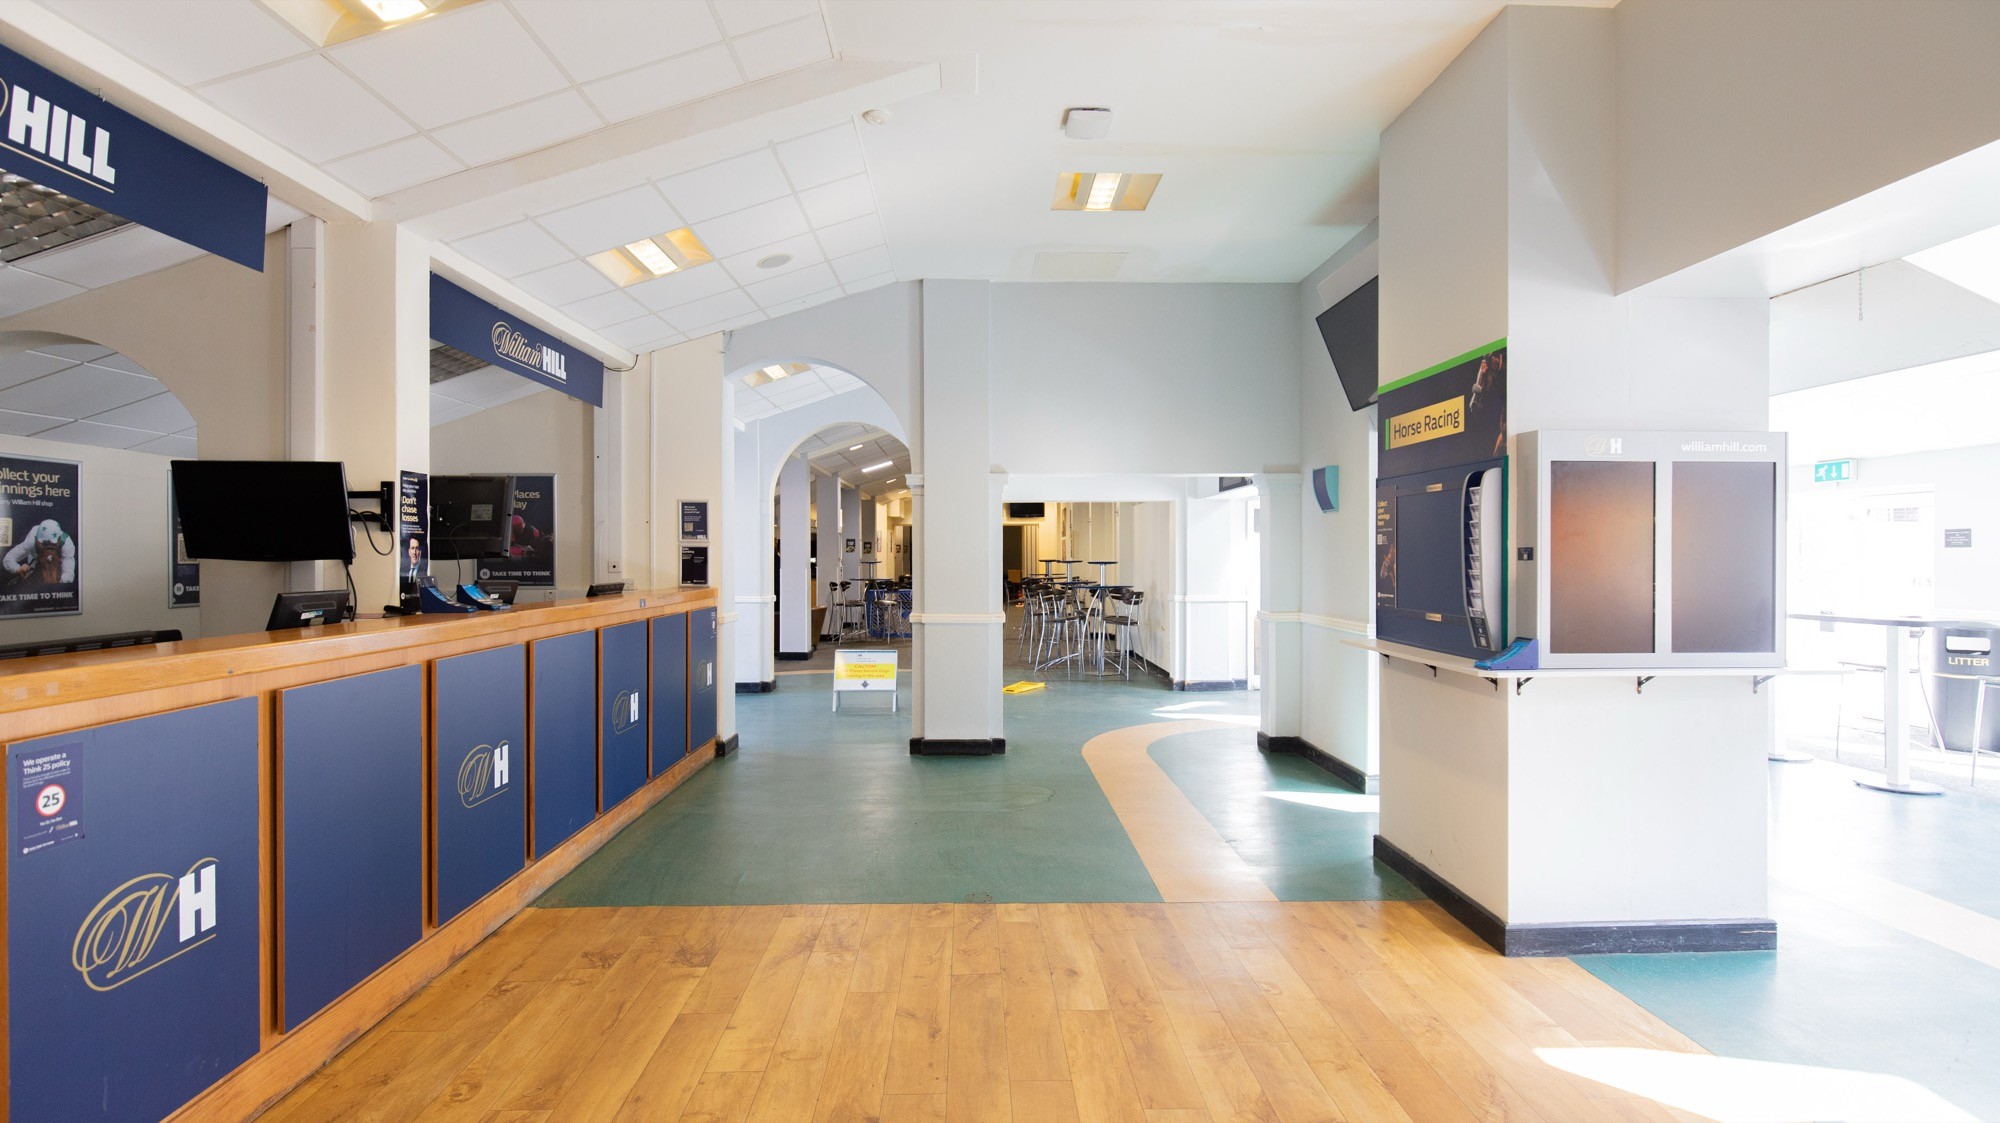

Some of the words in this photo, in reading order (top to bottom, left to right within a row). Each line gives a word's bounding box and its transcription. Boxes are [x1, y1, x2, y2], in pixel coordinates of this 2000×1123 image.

[8, 84, 116, 185] HILL
[491, 321, 543, 368] William
[542, 346, 567, 380] HILL
[1393, 421, 1422, 440] Horse
[1424, 408, 1460, 429] Racing
[1681, 441, 1767, 453] williamhill.com
[0, 467, 29, 481] ollect
[32, 472, 60, 484] your
[0, 482, 43, 498] innings
[45, 484, 71, 497] here
[402, 513, 419, 523] losses
[40, 592, 50, 600] TO
[52, 591, 74, 599] THINK
[1948, 656, 1990, 667] LITTER
[23, 759, 35, 767] We
[35, 754, 61, 765] operate
[23, 765, 42, 775] Think
[42, 763, 51, 771] 25
[51, 759, 71, 770] policy
[42, 792, 60, 808] 25
